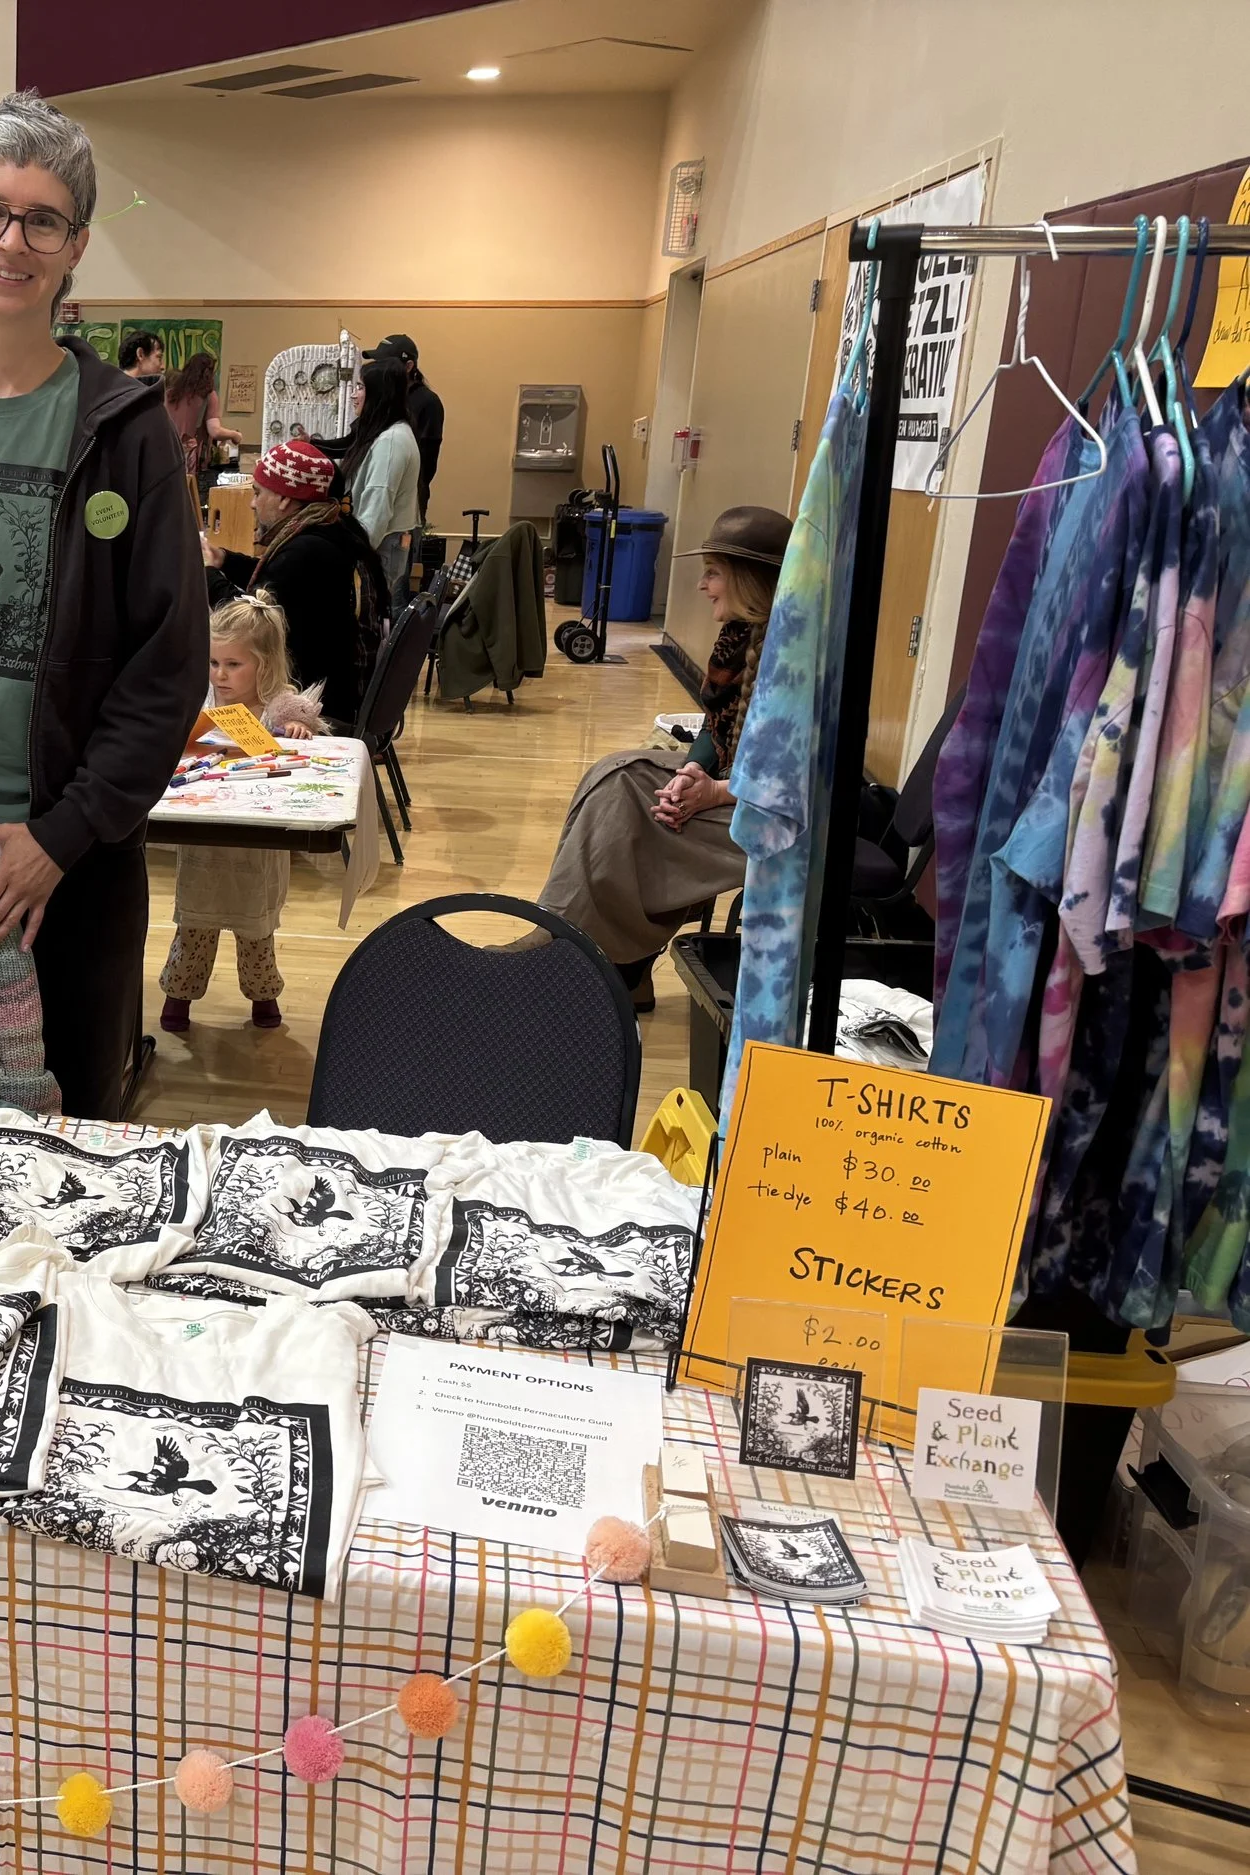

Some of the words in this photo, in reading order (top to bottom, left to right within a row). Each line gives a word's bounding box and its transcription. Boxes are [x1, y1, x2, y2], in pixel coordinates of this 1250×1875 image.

[91, 510, 125, 526] VOLUNTEER
[95, 505, 114, 516] EVENT
[817, 1078, 971, 1129] T-SHIRTS
[815, 1116, 844, 1132] 100%
[855, 1129, 904, 1145] organic
[915, 1136, 962, 1154] cotton
[763, 1142, 802, 1168] plain
[377, 1172, 413, 1186] GUILD'S
[221, 1245, 266, 1264] Plant
[298, 1263, 335, 1283] Scion
[789, 1247, 945, 1310] STICKERS
[803, 1313, 881, 1351] $2.00
[437, 1377, 459, 1387] Cash
[449, 1362, 521, 1381] PAYMENT
[525, 1376, 594, 1393] OPTIONS
[58, 1384, 129, 1398] HUMBOLDT
[135, 1396, 237, 1416] PERMACULTURE
[243, 1400, 285, 1413] UILD'S
[434, 1391, 462, 1402] Check
[476, 1398, 522, 1412] Humboldt
[524, 1407, 586, 1423] Permaculture
[588, 1417, 614, 1427] Guild
[947, 1398, 1003, 1423] Seed
[432, 1406, 464, 1417] Venmo
[466, 1412, 608, 1442] @humboldtpermacultureguild
[931, 1420, 949, 1442] &
[956, 1422, 1020, 1450] Plant
[764, 1454, 784, 1466] Plant
[785, 1458, 795, 1467] &
[797, 1460, 816, 1471] Scion
[818, 1463, 849, 1478] Exchange
[925, 1445, 1025, 1481] Exchange
[481, 1496, 558, 1518] venmo
[931, 1562, 951, 1578] &
[957, 1566, 1024, 1584] Plant
[940, 1552, 997, 1568] Seed
[933, 1576, 1037, 1601] Exchange
